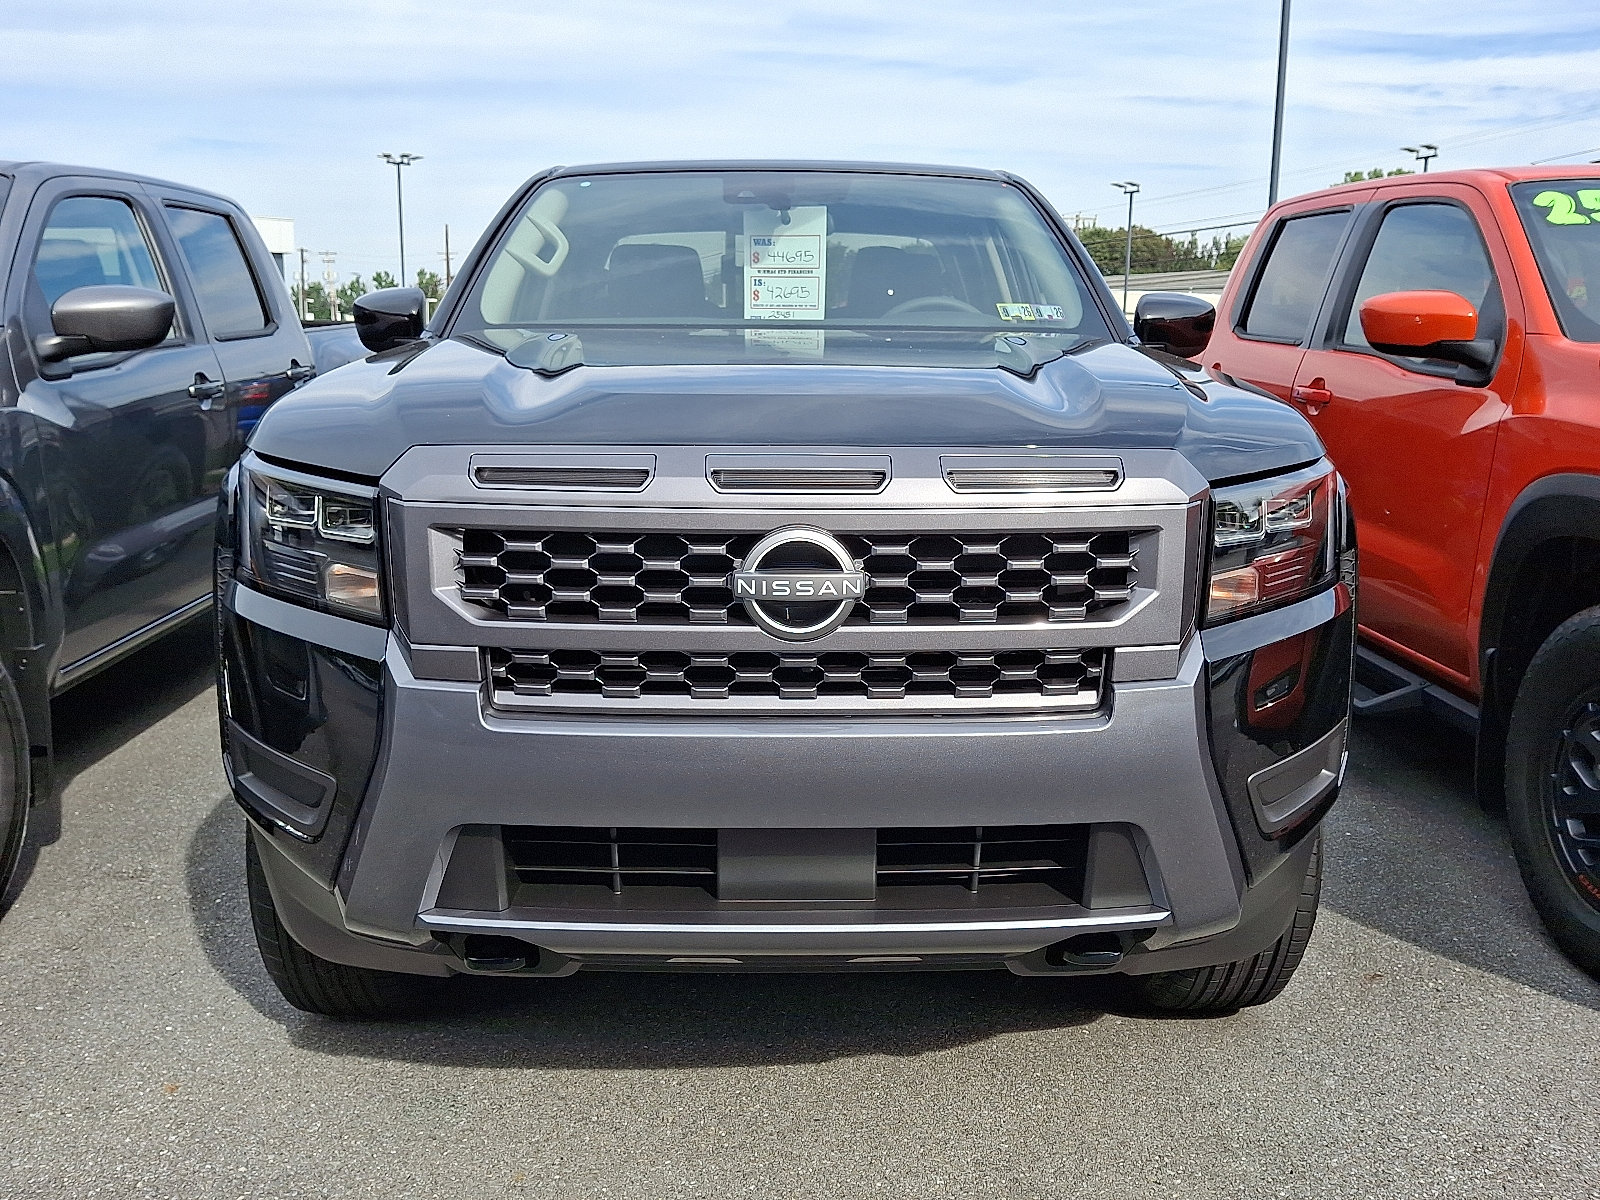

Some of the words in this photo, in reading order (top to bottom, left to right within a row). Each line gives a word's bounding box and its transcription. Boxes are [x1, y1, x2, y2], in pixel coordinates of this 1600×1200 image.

[753, 238, 775, 246] WAS:
[753, 252, 760, 263] $
[767, 250, 814, 263] 44695
[753, 278, 766, 287] IS:
[753, 290, 760, 301] $
[766, 285, 811, 300] 42695
[737, 578, 861, 596] NISSAN
